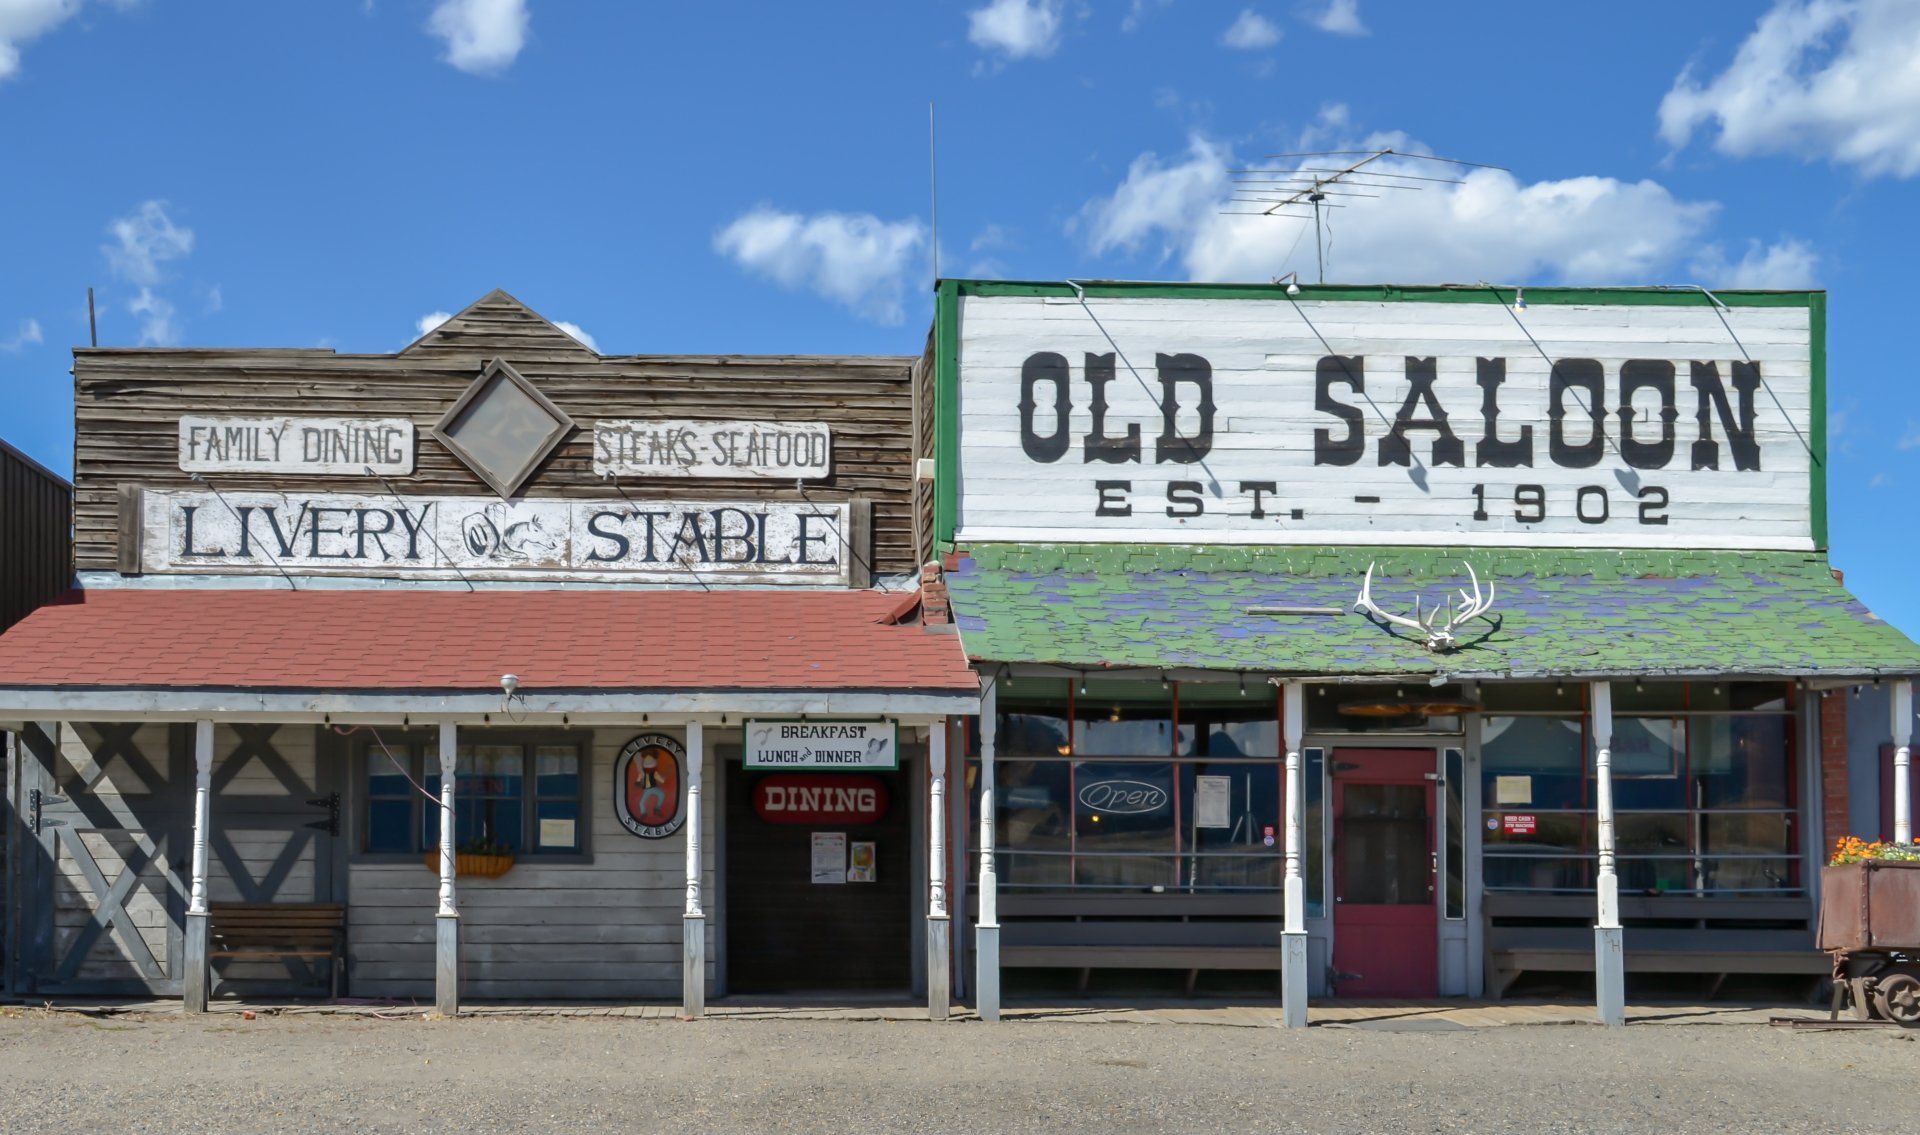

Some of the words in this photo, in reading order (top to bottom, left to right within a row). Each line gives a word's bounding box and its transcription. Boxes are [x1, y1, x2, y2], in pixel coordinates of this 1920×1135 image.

[1017, 351, 1218, 464] OLD
[1314, 355, 1761, 471] SALOON
[188, 420, 288, 463] FAMILY
[302, 427, 404, 465] DINING
[1095, 480, 1303, 519] EST.
[1471, 483, 1669, 525] 1902
[180, 500, 434, 561] LIVERY
[586, 507, 839, 565] STABLE
[781, 726, 867, 739] BREAKFAST
[625, 736, 682, 756] LIVERY
[758, 750, 798, 763] LUNCH
[799, 746, 813, 762] and
[815, 750, 862, 763] DINNER
[765, 786, 876, 812] DINING
[1087, 784, 1158, 809] Open
[624, 816, 680, 836] STABLE
